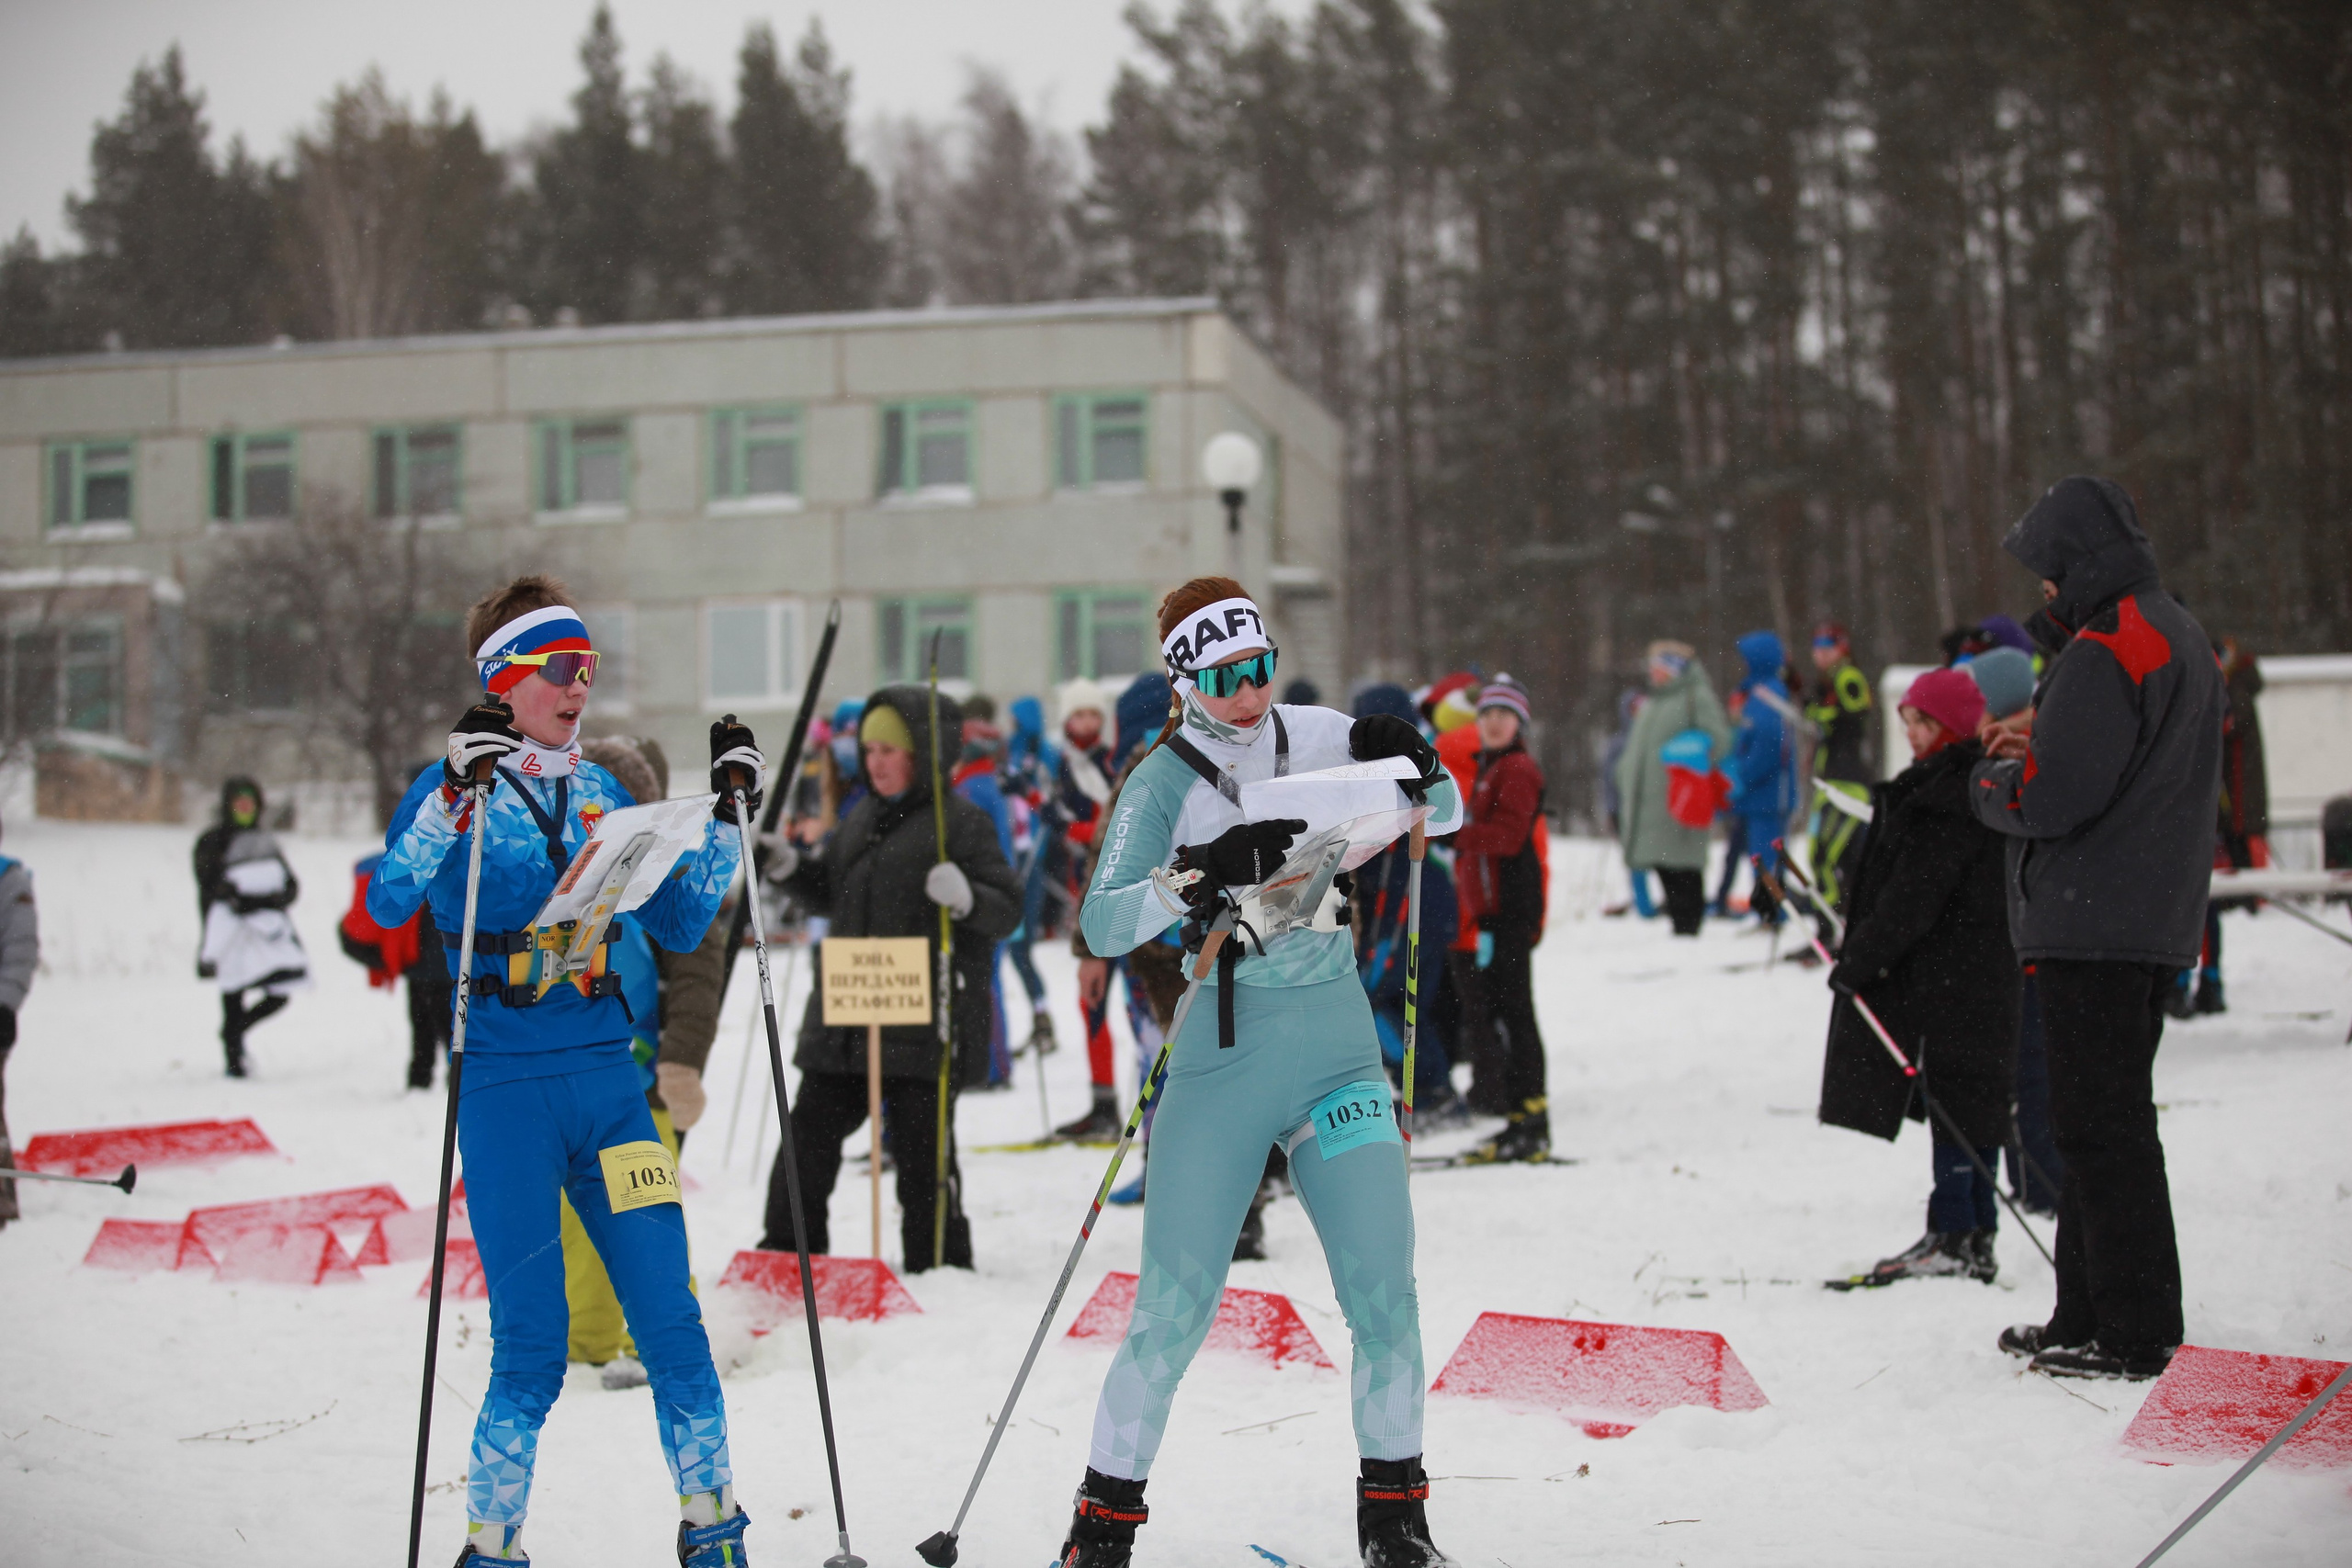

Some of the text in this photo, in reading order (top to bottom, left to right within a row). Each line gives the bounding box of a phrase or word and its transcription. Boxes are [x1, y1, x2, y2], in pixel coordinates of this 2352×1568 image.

[851, 953, 895, 966] ЗОНА
[830, 973, 921, 988] ПЕРЕДАЧИ
[831, 993, 923, 1009] ЭСТАФЕТЫ
[1325, 1100, 1382, 1130] 103.2
[1364, 1490, 1407, 1500] ROSSIGNOL
[1113, 1512, 1147, 1521] ROSSIGNO
